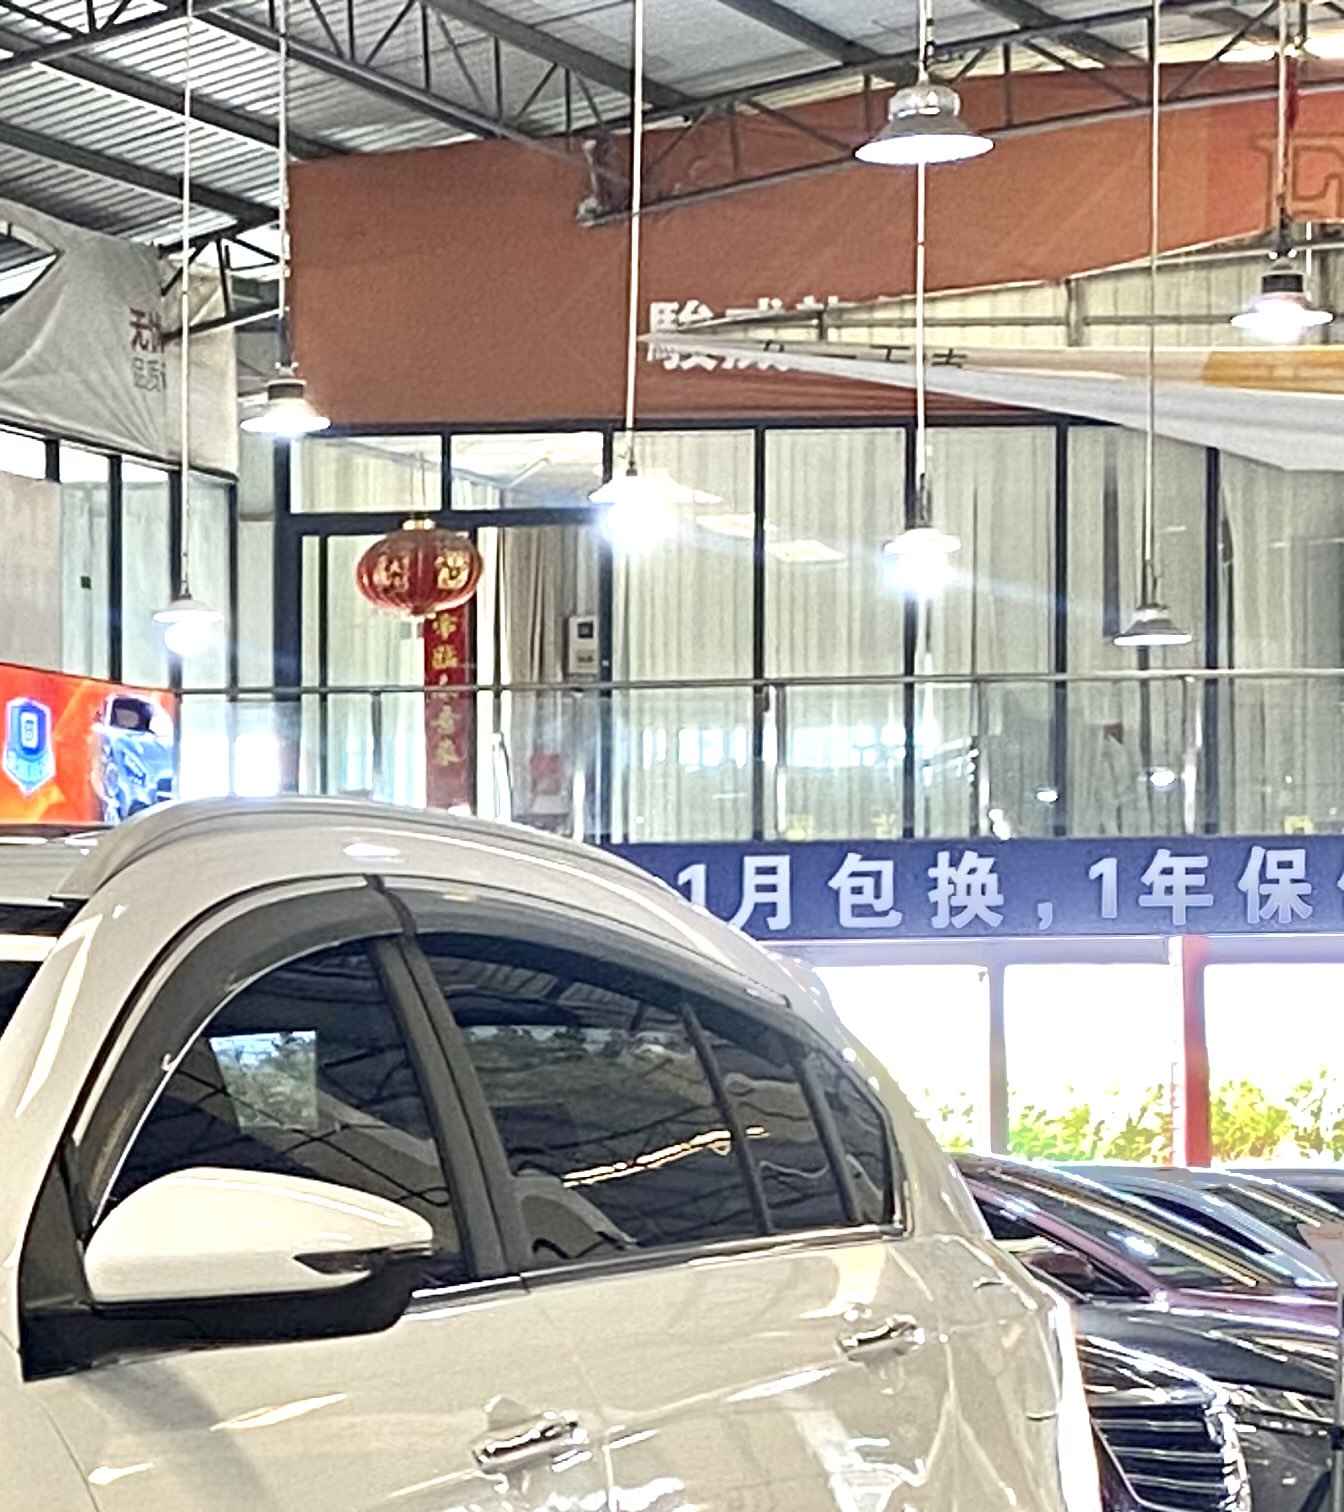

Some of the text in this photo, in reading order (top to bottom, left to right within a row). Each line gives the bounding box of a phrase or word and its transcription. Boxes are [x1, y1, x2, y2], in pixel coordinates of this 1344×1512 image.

[678, 846, 1344, 931] 1月包换，1年保
